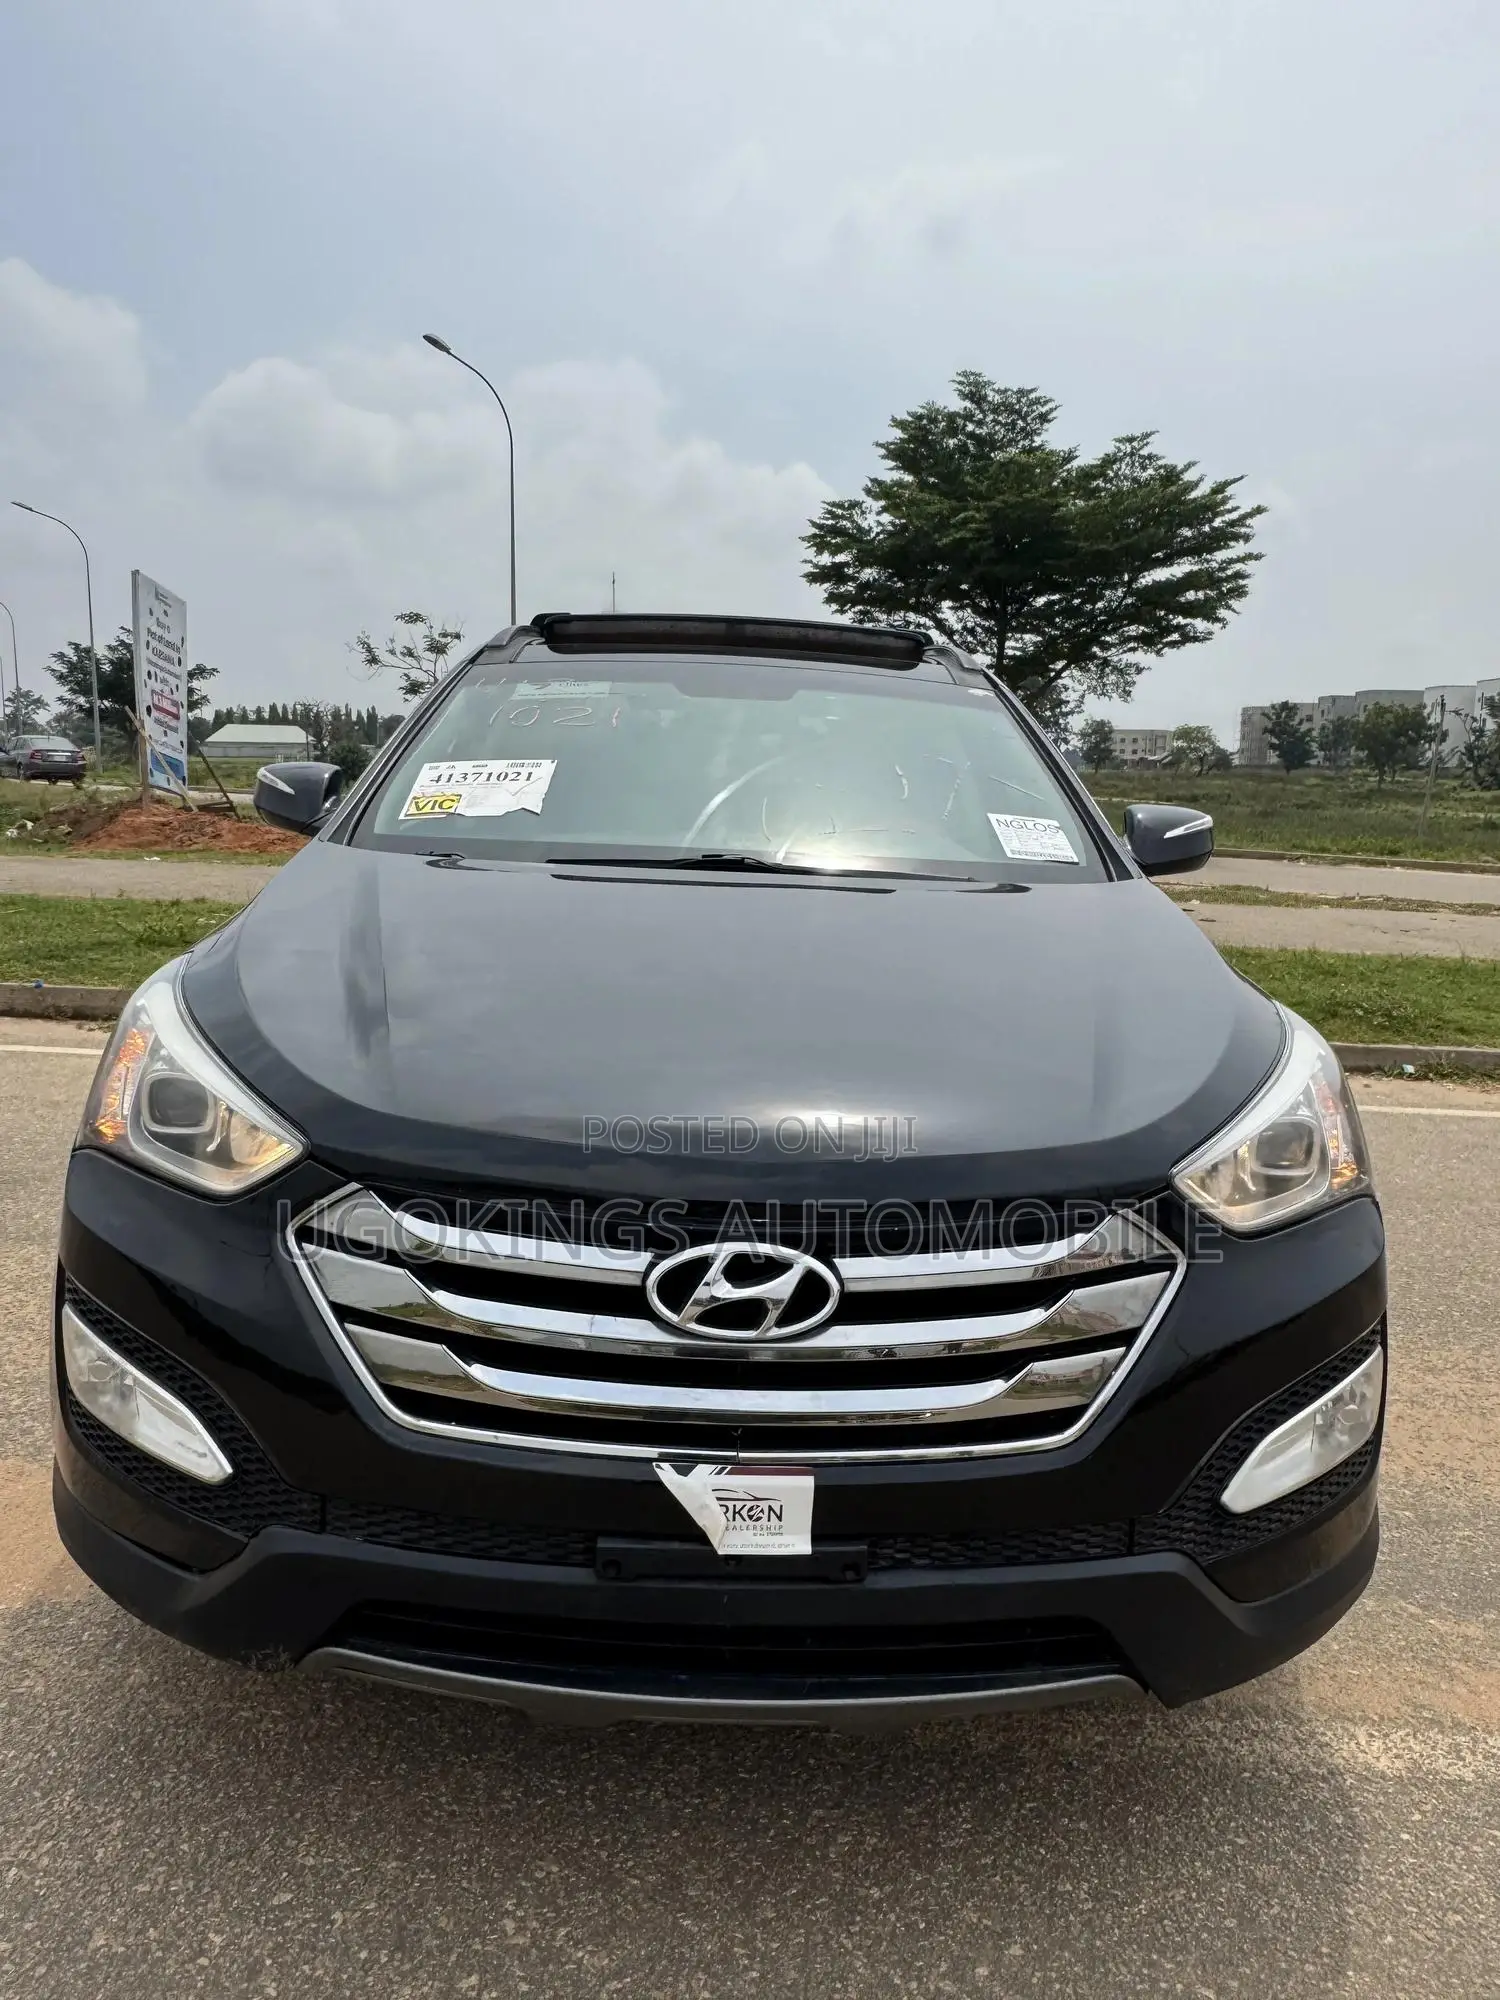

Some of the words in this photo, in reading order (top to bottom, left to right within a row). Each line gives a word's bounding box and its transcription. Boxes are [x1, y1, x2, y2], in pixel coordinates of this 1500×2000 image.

[429, 771, 533, 784] 41371021
[413, 798, 456, 812] VIC
[719, 1504, 783, 1522] RKON
